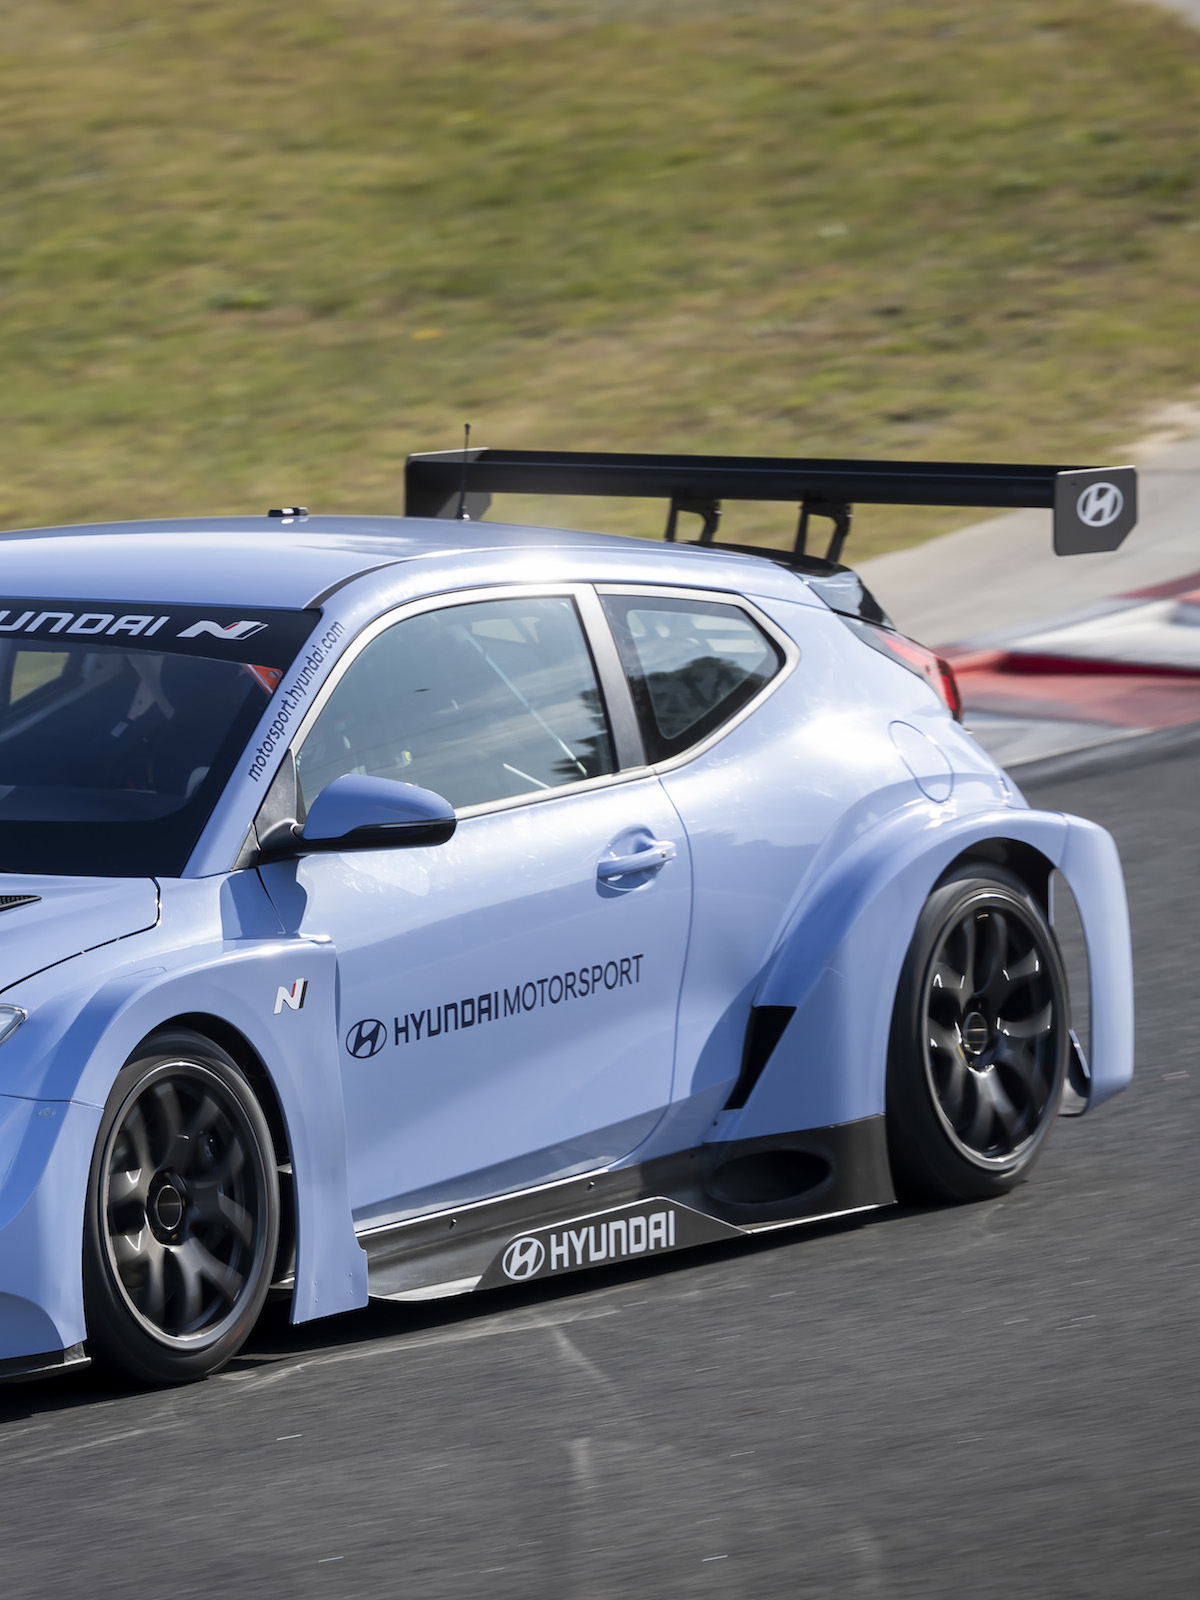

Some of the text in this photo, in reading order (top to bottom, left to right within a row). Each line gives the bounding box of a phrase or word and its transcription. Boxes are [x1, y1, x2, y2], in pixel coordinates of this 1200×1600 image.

[248, 621, 346, 782] motorsport.hyundai.com
[394, 991, 499, 1046] HYUNDAI
[503, 954, 644, 1017] MOTORSPORT
[550, 1210, 676, 1270] HYUNDAI
